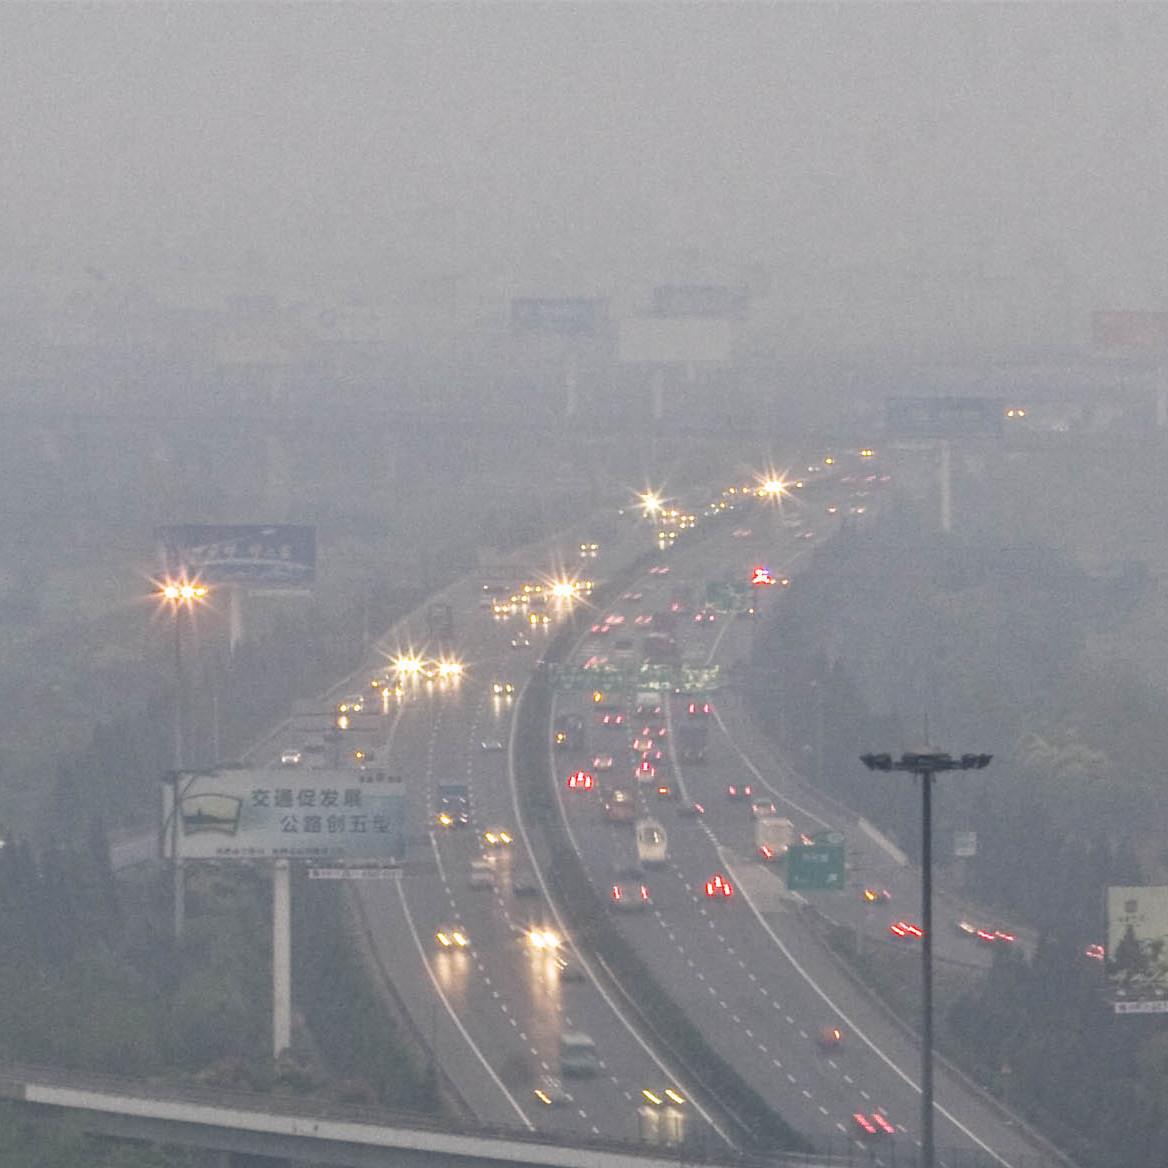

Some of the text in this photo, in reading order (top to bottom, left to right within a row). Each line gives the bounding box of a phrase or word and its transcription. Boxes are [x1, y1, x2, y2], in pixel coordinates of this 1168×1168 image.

[251, 788, 362, 808] 交通促发展
